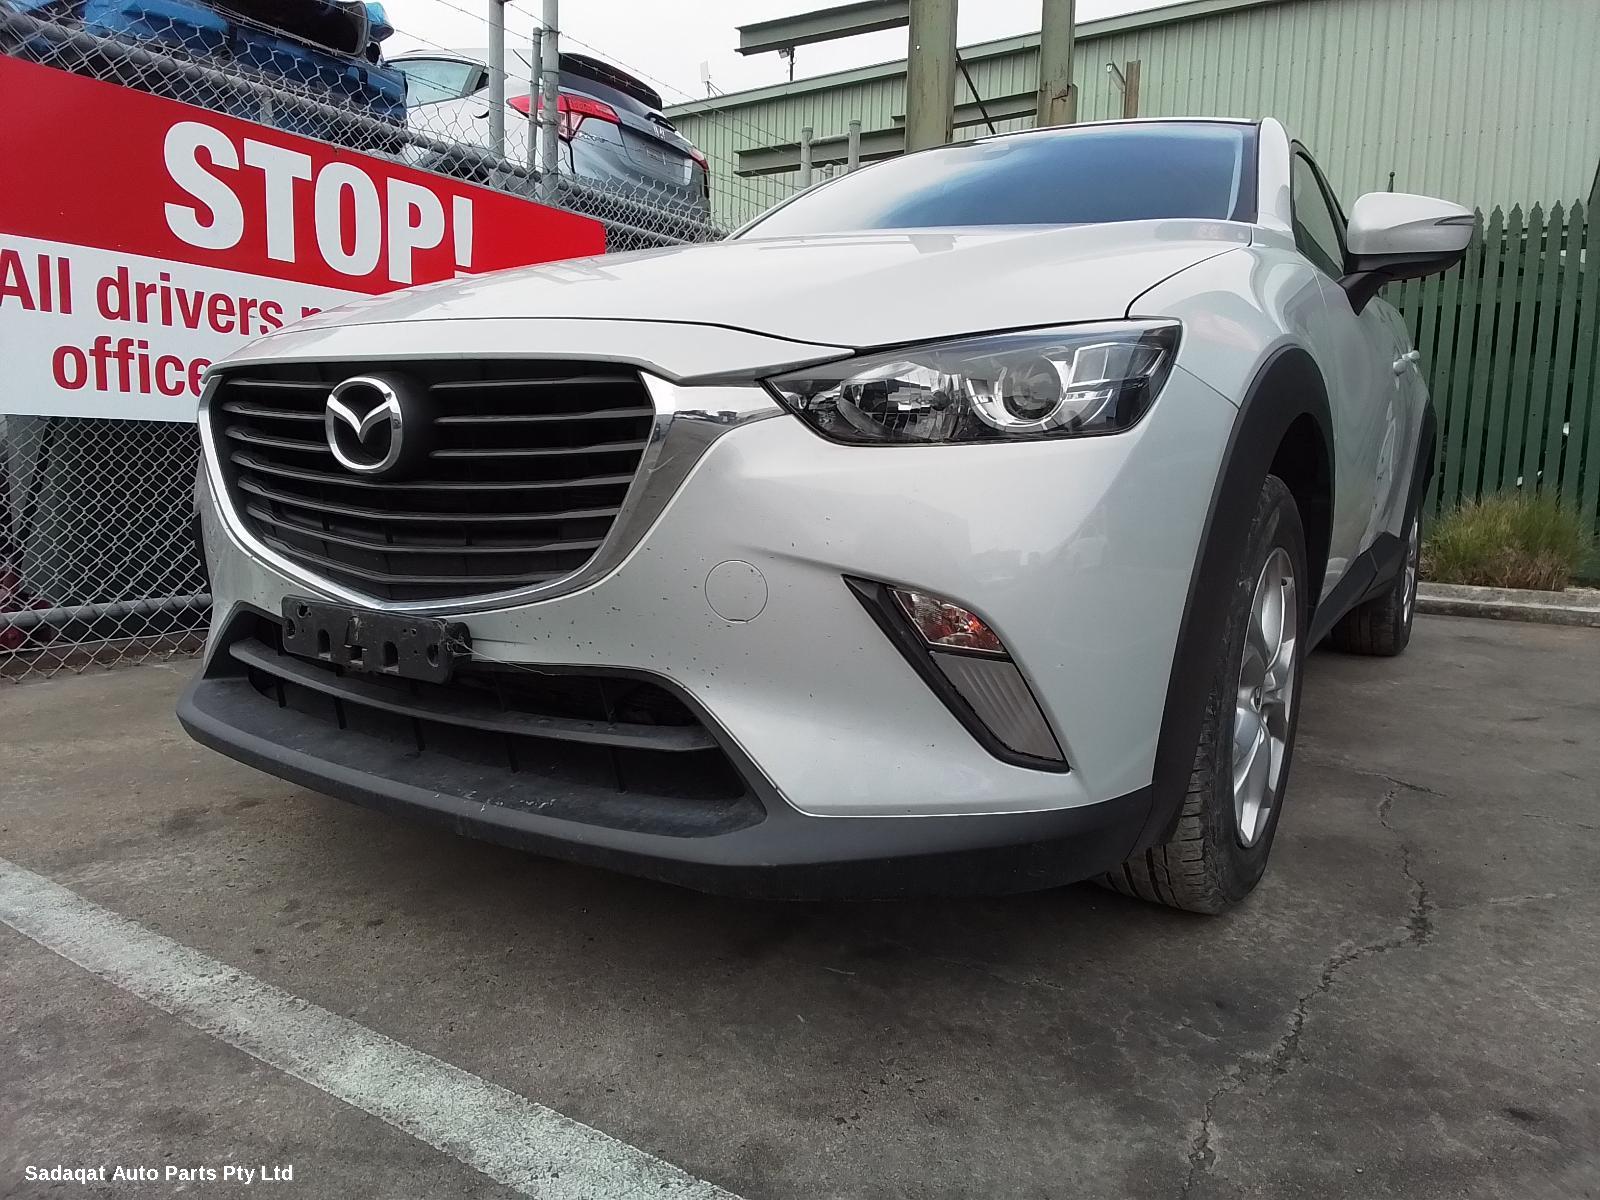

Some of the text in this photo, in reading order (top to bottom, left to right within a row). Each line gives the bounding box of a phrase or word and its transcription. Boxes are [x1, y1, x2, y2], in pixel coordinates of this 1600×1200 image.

[164, 121, 473, 284] STOP!
[0, 248, 284, 336] All drivers
